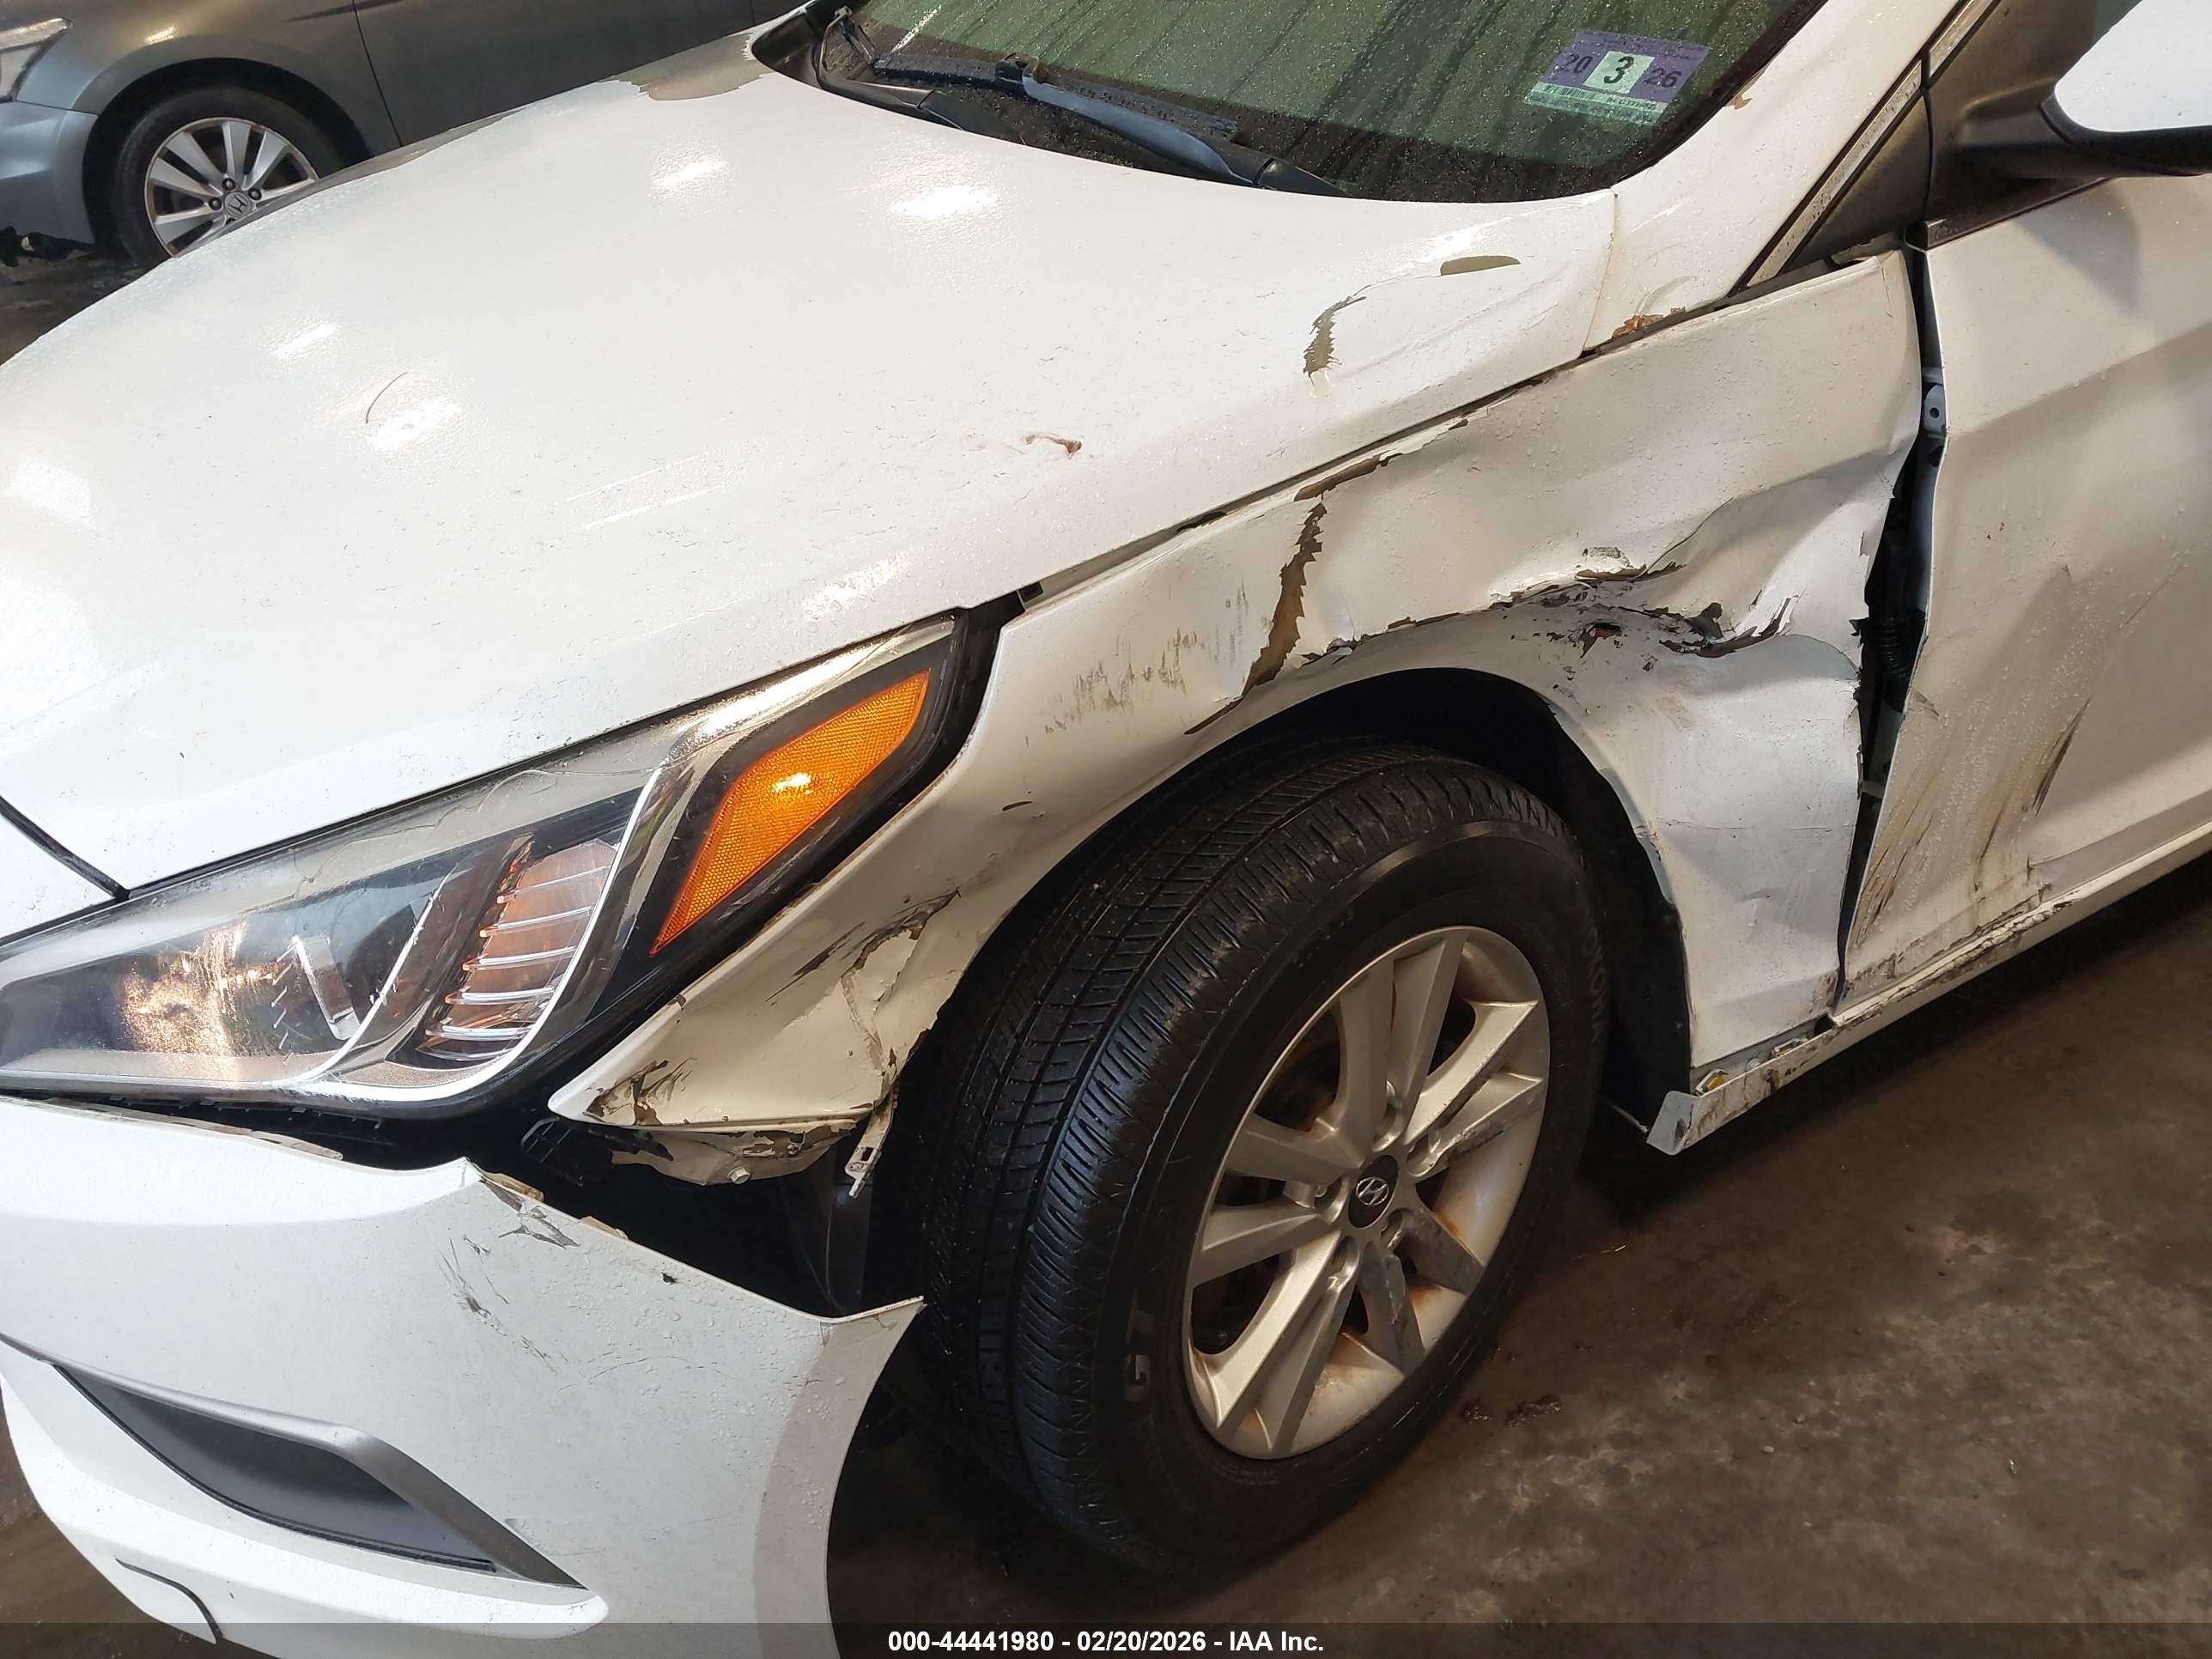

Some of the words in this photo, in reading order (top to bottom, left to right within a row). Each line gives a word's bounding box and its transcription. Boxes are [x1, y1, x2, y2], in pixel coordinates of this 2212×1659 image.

[1563, 52, 1594, 74] 20
[1603, 56, 1635, 85] 3
[1644, 68, 1683, 88] 26
